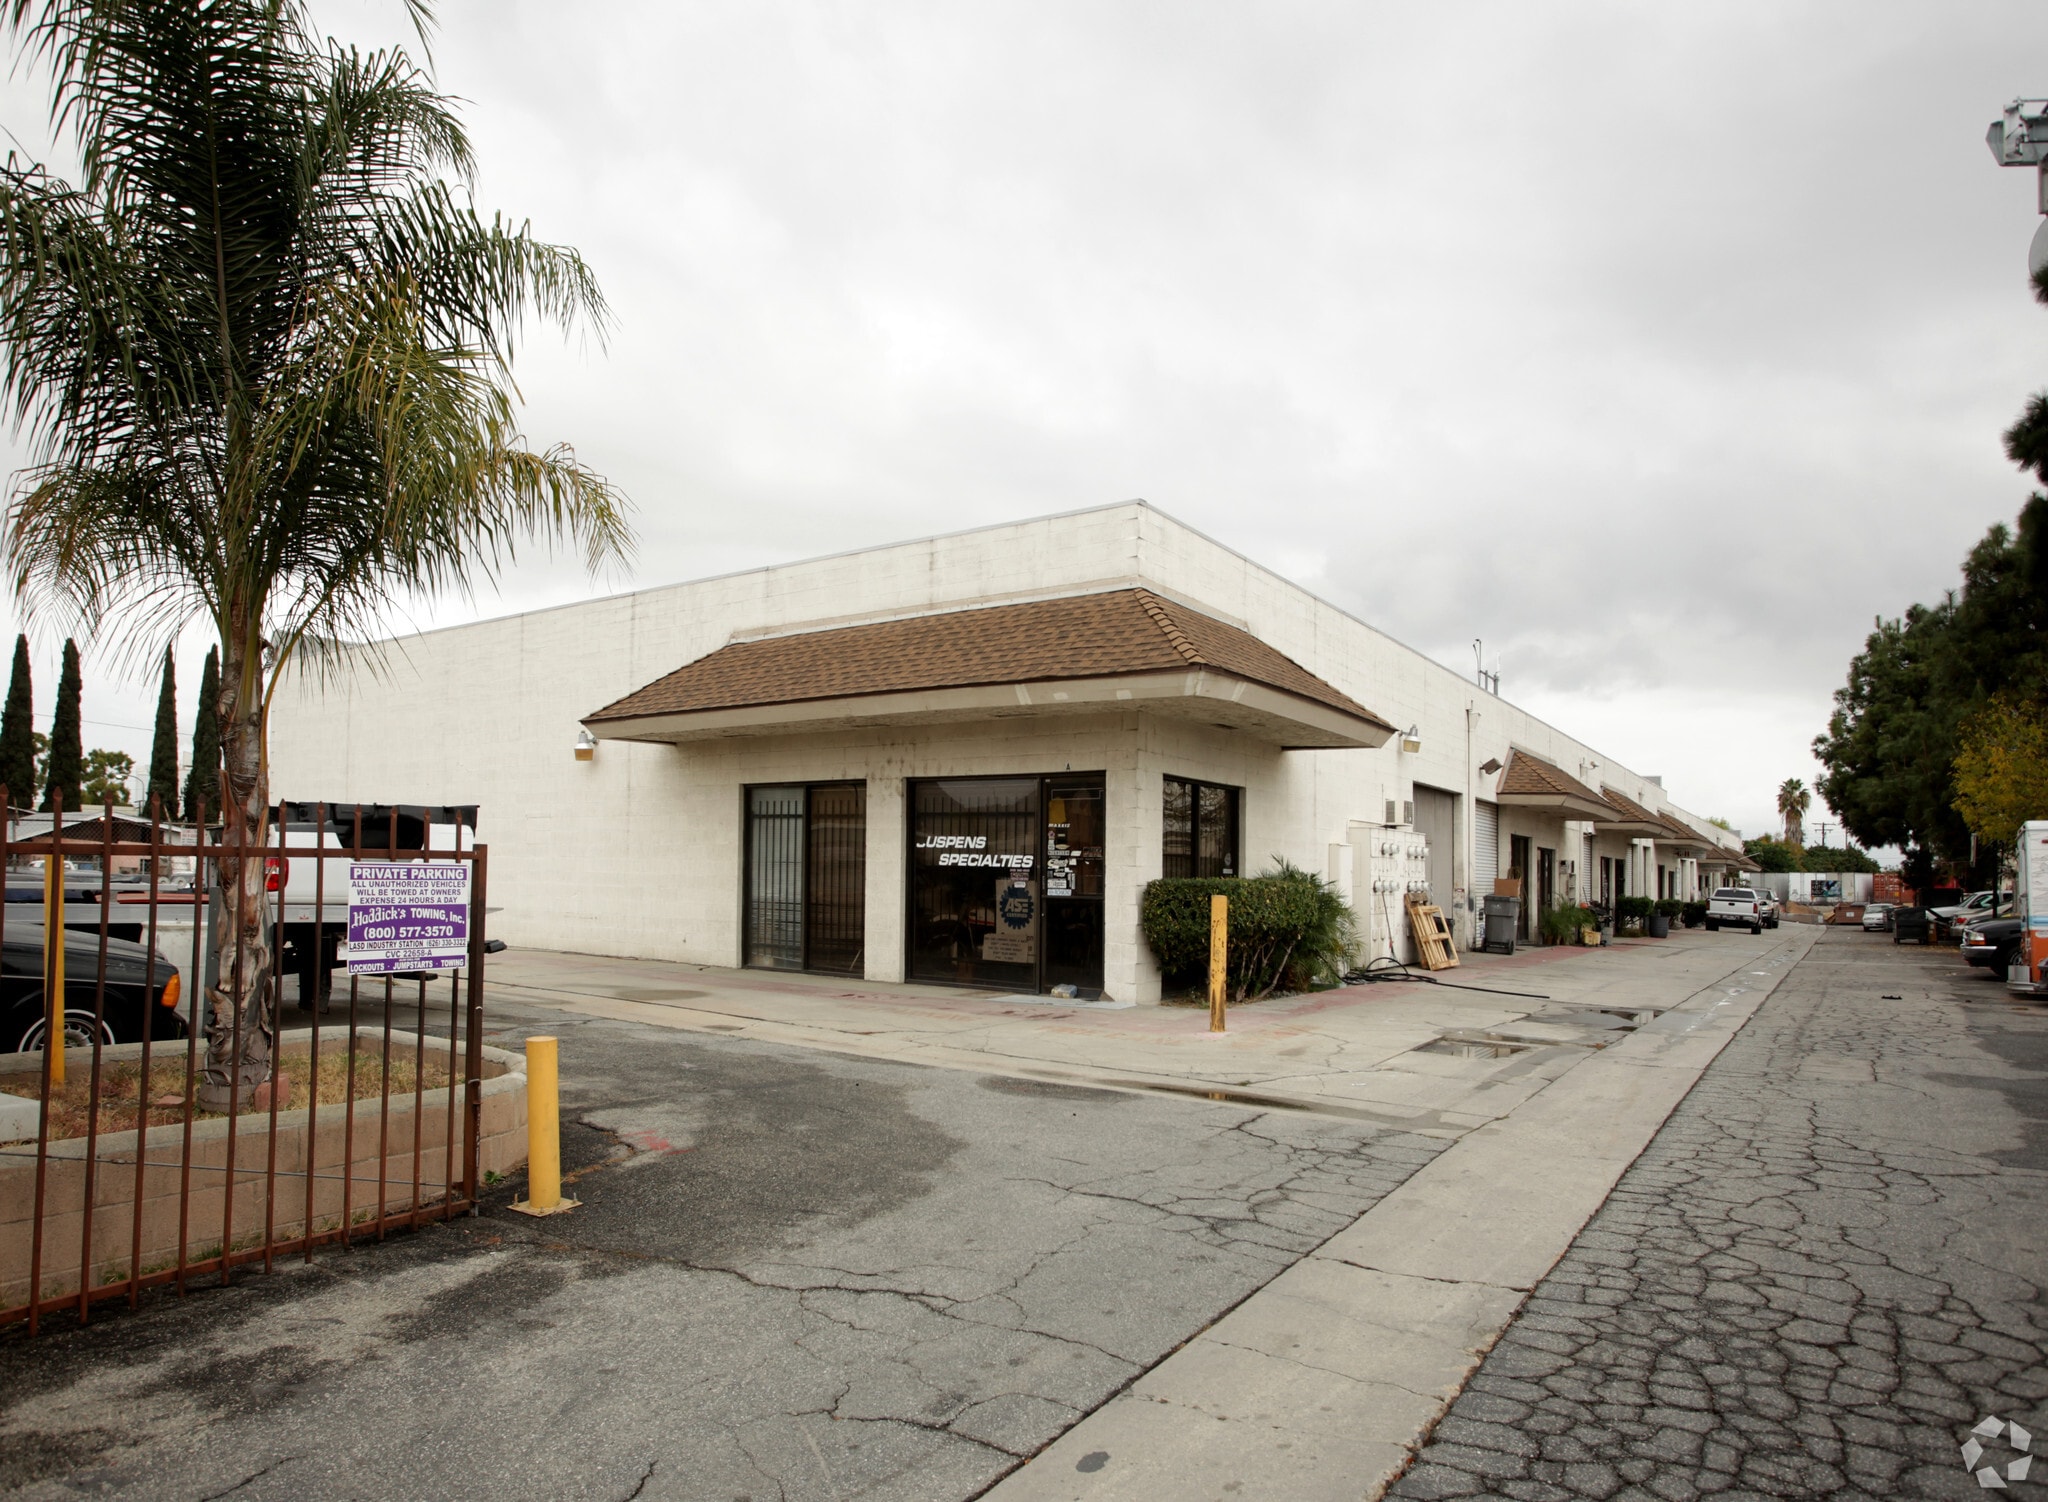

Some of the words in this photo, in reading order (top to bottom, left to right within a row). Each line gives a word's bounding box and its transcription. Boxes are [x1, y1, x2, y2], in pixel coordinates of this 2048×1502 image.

[938, 853, 1034, 868] SPECIALTIES
[353, 868, 408, 879] PRIVATE
[411, 868, 464, 880] PARKING
[368, 880, 429, 888] UNAUTHORIZED
[431, 880, 466, 888] VEHICLES
[430, 888, 461, 896] OWNERS
[1005, 898, 1029, 913] ASE
[351, 906, 406, 928] Haddick's
[410, 907, 448, 922] TOWING,
[449, 911, 465, 924] Inc.
[363, 926, 396, 940] (800)
[399, 925, 453, 938] 577-3570
[349, 942, 364, 950] LASD
[366, 941, 397, 949] INDUSTRY
[399, 940, 424, 948] STATION
[427, 939, 440, 947] (626)
[403, 949, 432, 957] 22658-A
[350, 963, 385, 972] LOCKOUTS
[393, 960, 433, 970] JUMPSTARTS
[440, 959, 464, 967] TOWING
